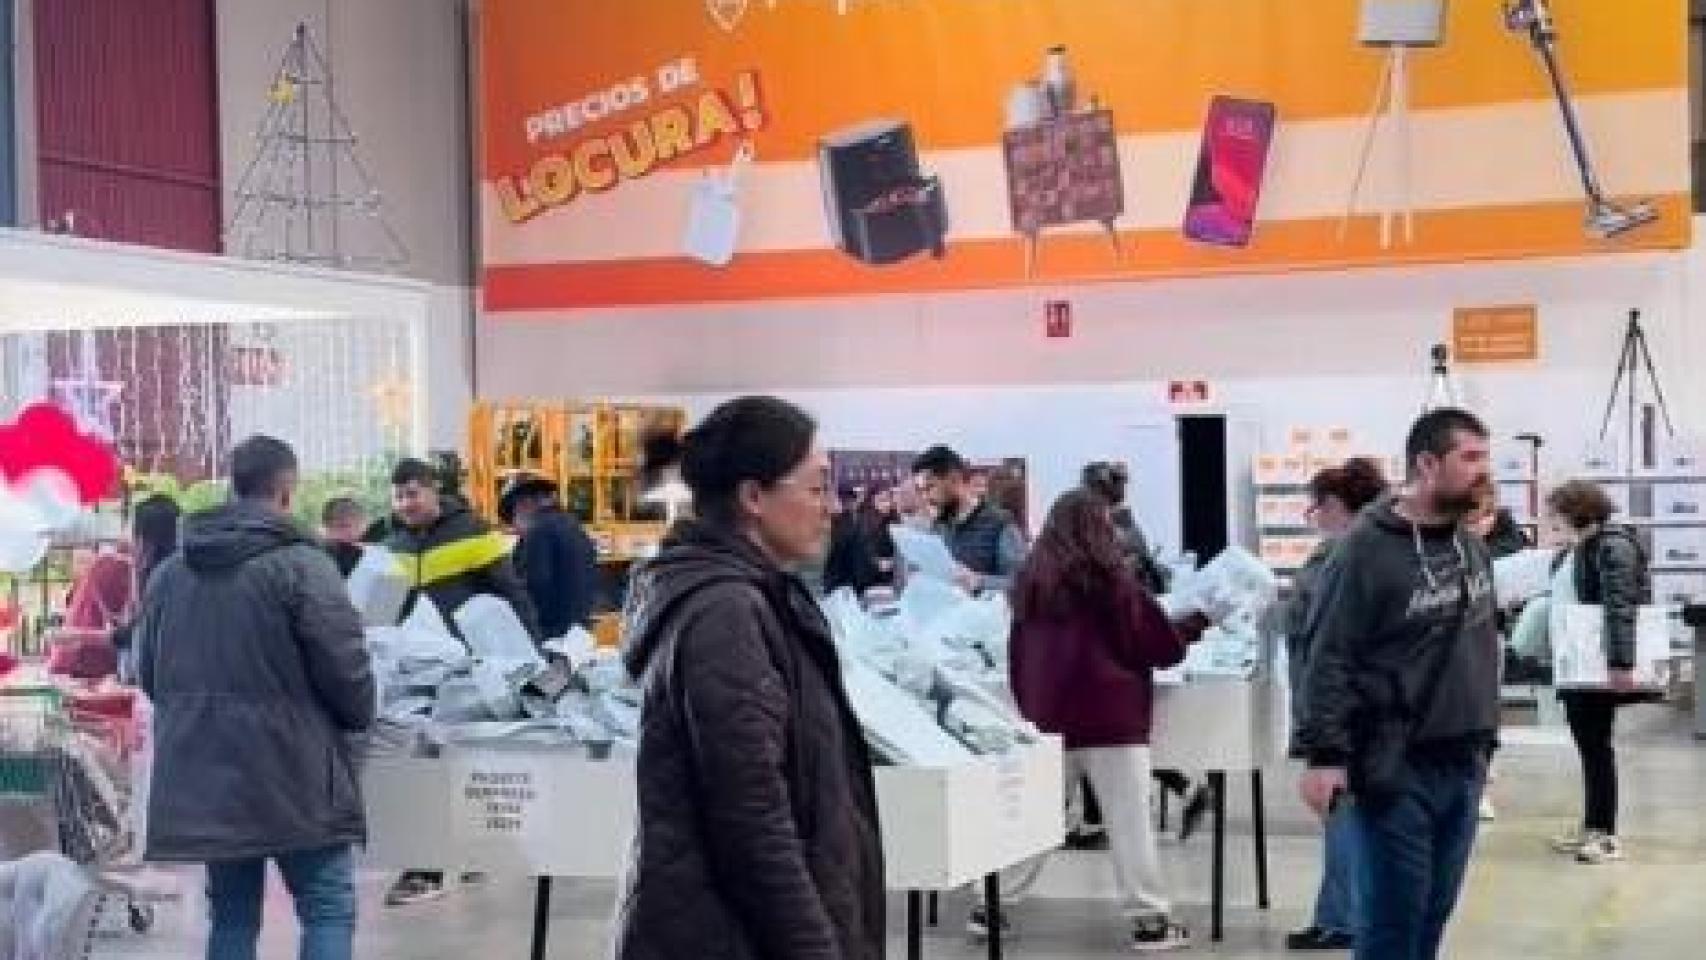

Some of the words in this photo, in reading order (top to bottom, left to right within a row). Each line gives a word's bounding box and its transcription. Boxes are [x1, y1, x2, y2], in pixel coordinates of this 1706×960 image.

[497, 70, 763, 222] LOCURA!
[525, 77, 650, 143] PRECIOS
[658, 57, 698, 92] DE
